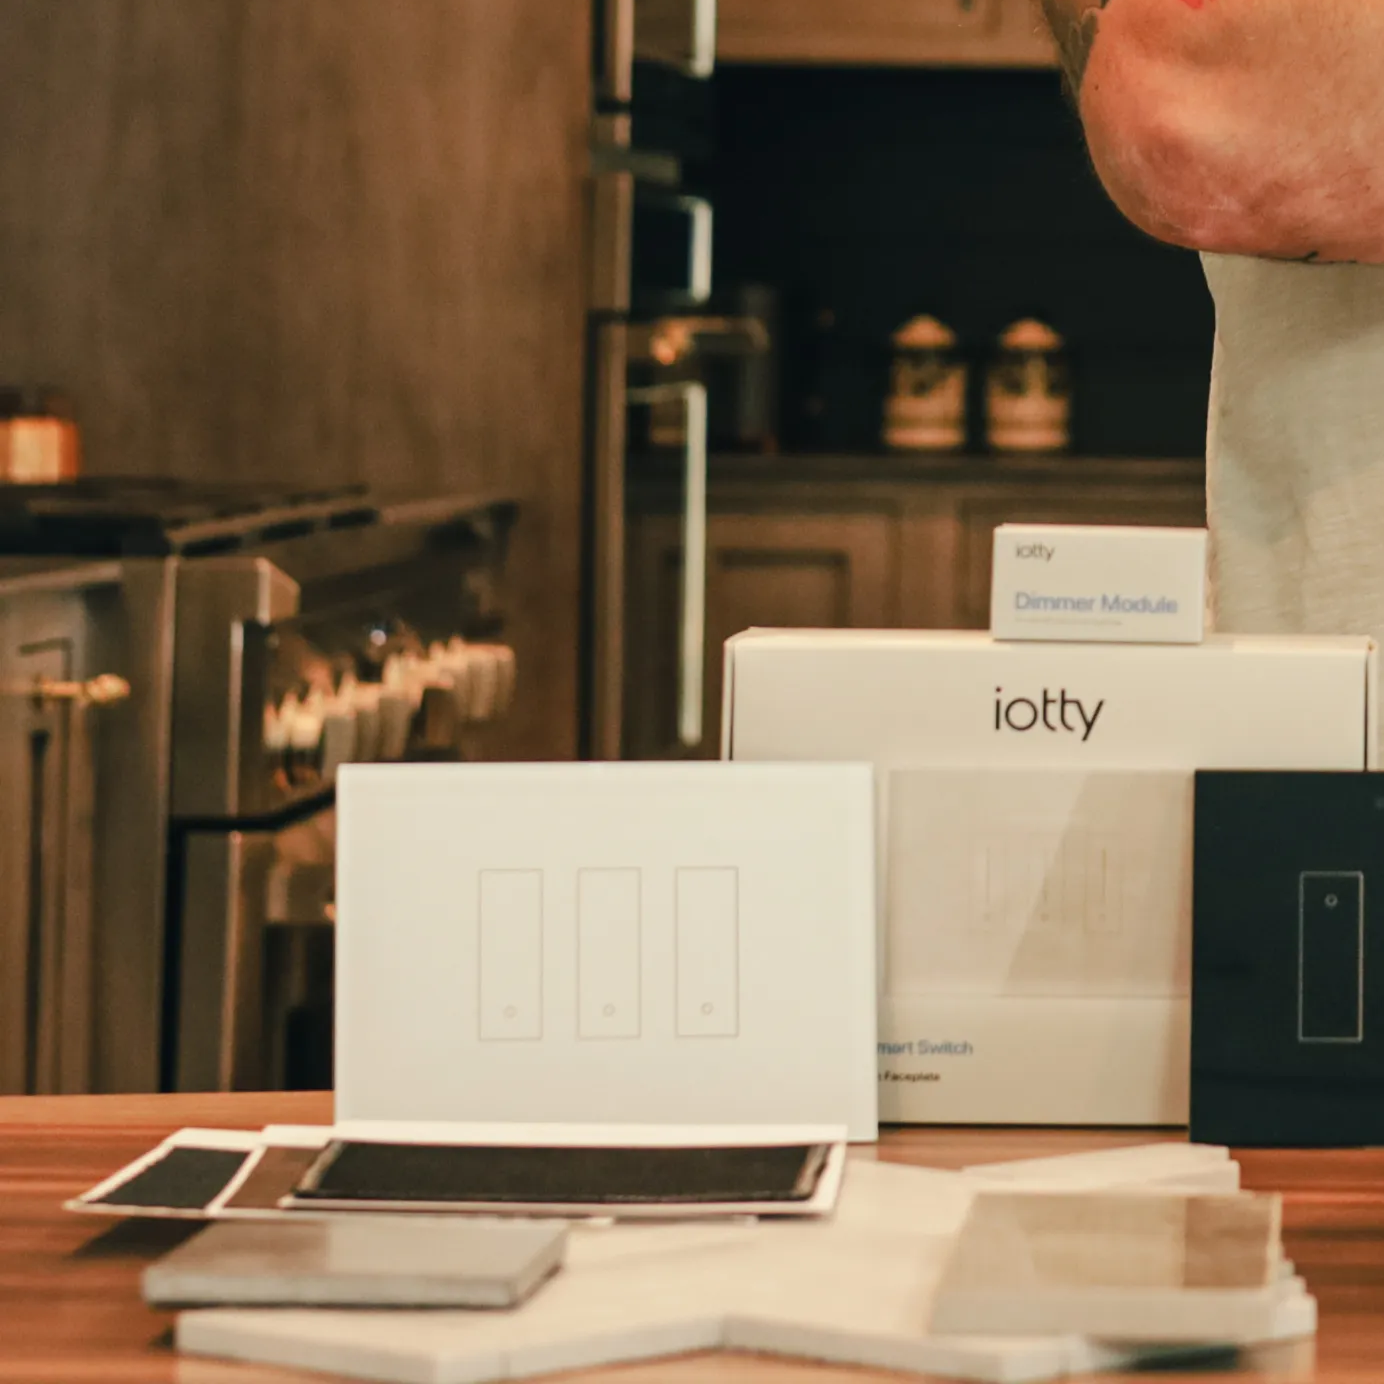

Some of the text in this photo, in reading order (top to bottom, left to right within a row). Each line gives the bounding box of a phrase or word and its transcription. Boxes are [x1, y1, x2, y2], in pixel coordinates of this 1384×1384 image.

[1015, 542, 1055, 562] iotty
[1014, 591, 1178, 614] Dimmer Module
[995, 686, 1105, 742] iotty
[877, 1038, 974, 1056] mart Switch
